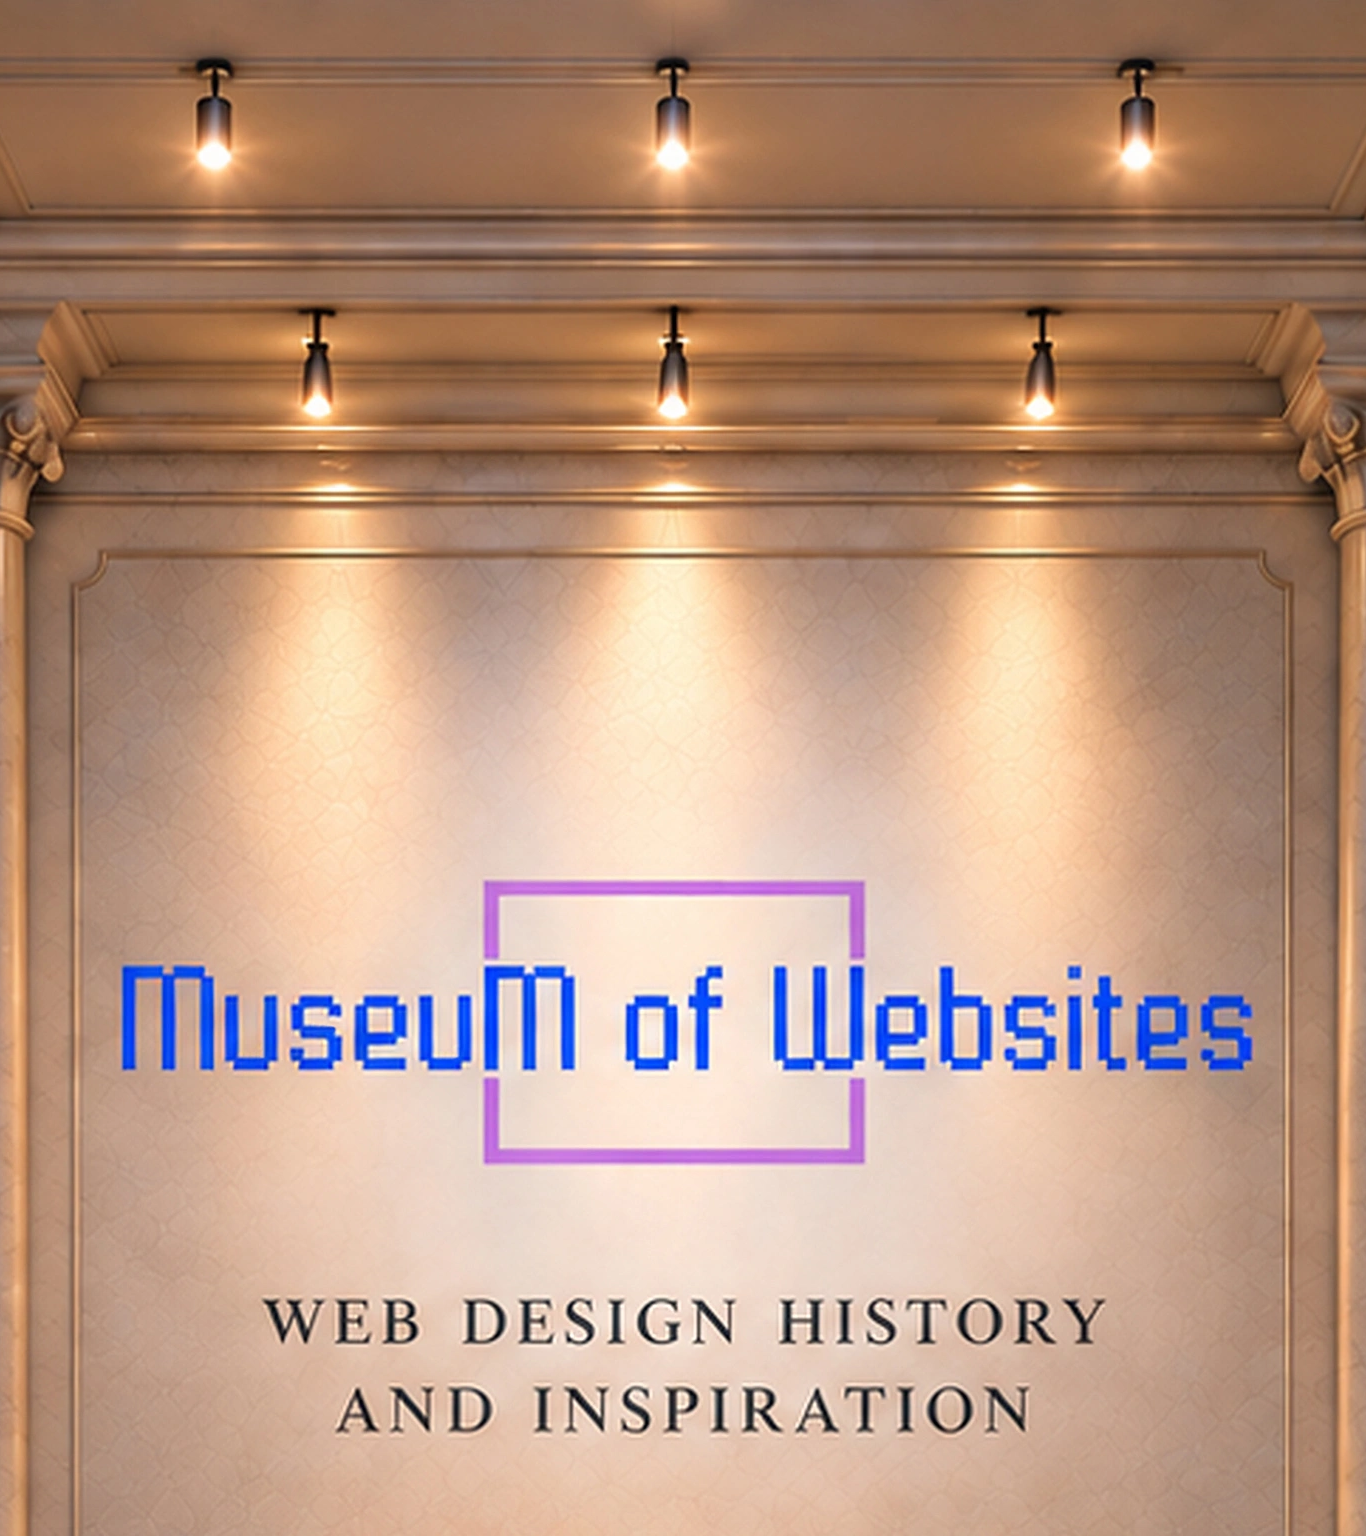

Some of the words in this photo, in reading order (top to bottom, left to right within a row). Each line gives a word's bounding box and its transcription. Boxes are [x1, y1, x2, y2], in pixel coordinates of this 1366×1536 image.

[626, 966, 723, 1070] of
[774, 966, 1252, 1070] Websites
[263, 1299, 418, 1344] WEB
[463, 1298, 735, 1345] DESIGN
[780, 1298, 1105, 1345] HISTORY
[336, 1387, 492, 1432] AND
[535, 1386, 1029, 1434] INSPIRATION
